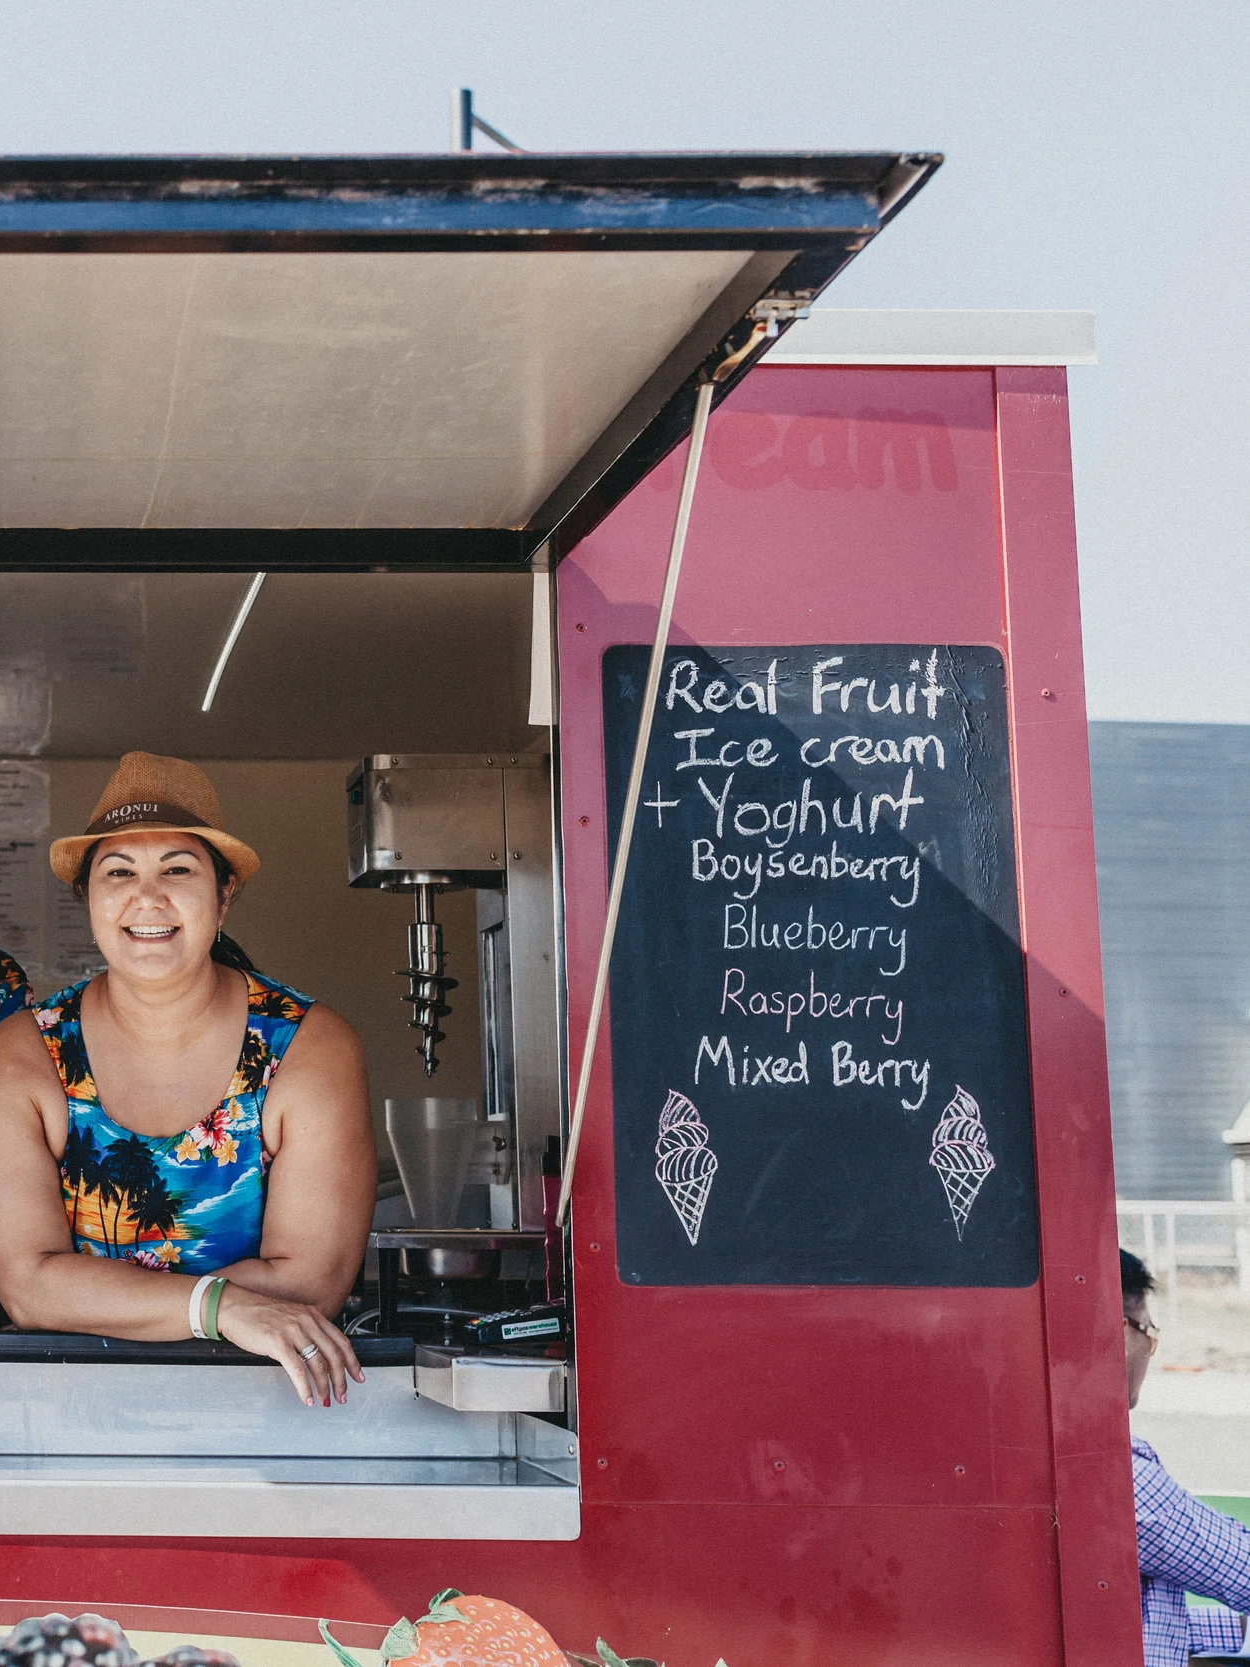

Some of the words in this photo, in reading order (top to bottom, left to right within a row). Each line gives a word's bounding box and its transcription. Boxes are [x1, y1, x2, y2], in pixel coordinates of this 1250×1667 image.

[666, 659, 777, 715] Real
[812, 648, 945, 720] Fruit
[674, 727, 779, 771] Ice
[800, 734, 945, 771] cream
[104, 803, 158, 823] ARONUI
[643, 780, 680, 829] +
[698, 766, 924, 849] Yoghurt
[691, 838, 920, 908] Boysenberry
[723, 903, 907, 976] Blueberry
[721, 968, 903, 1046] Raspberry
[694, 1035, 810, 1086] Mixed
[832, 1040, 930, 1110] Berry
